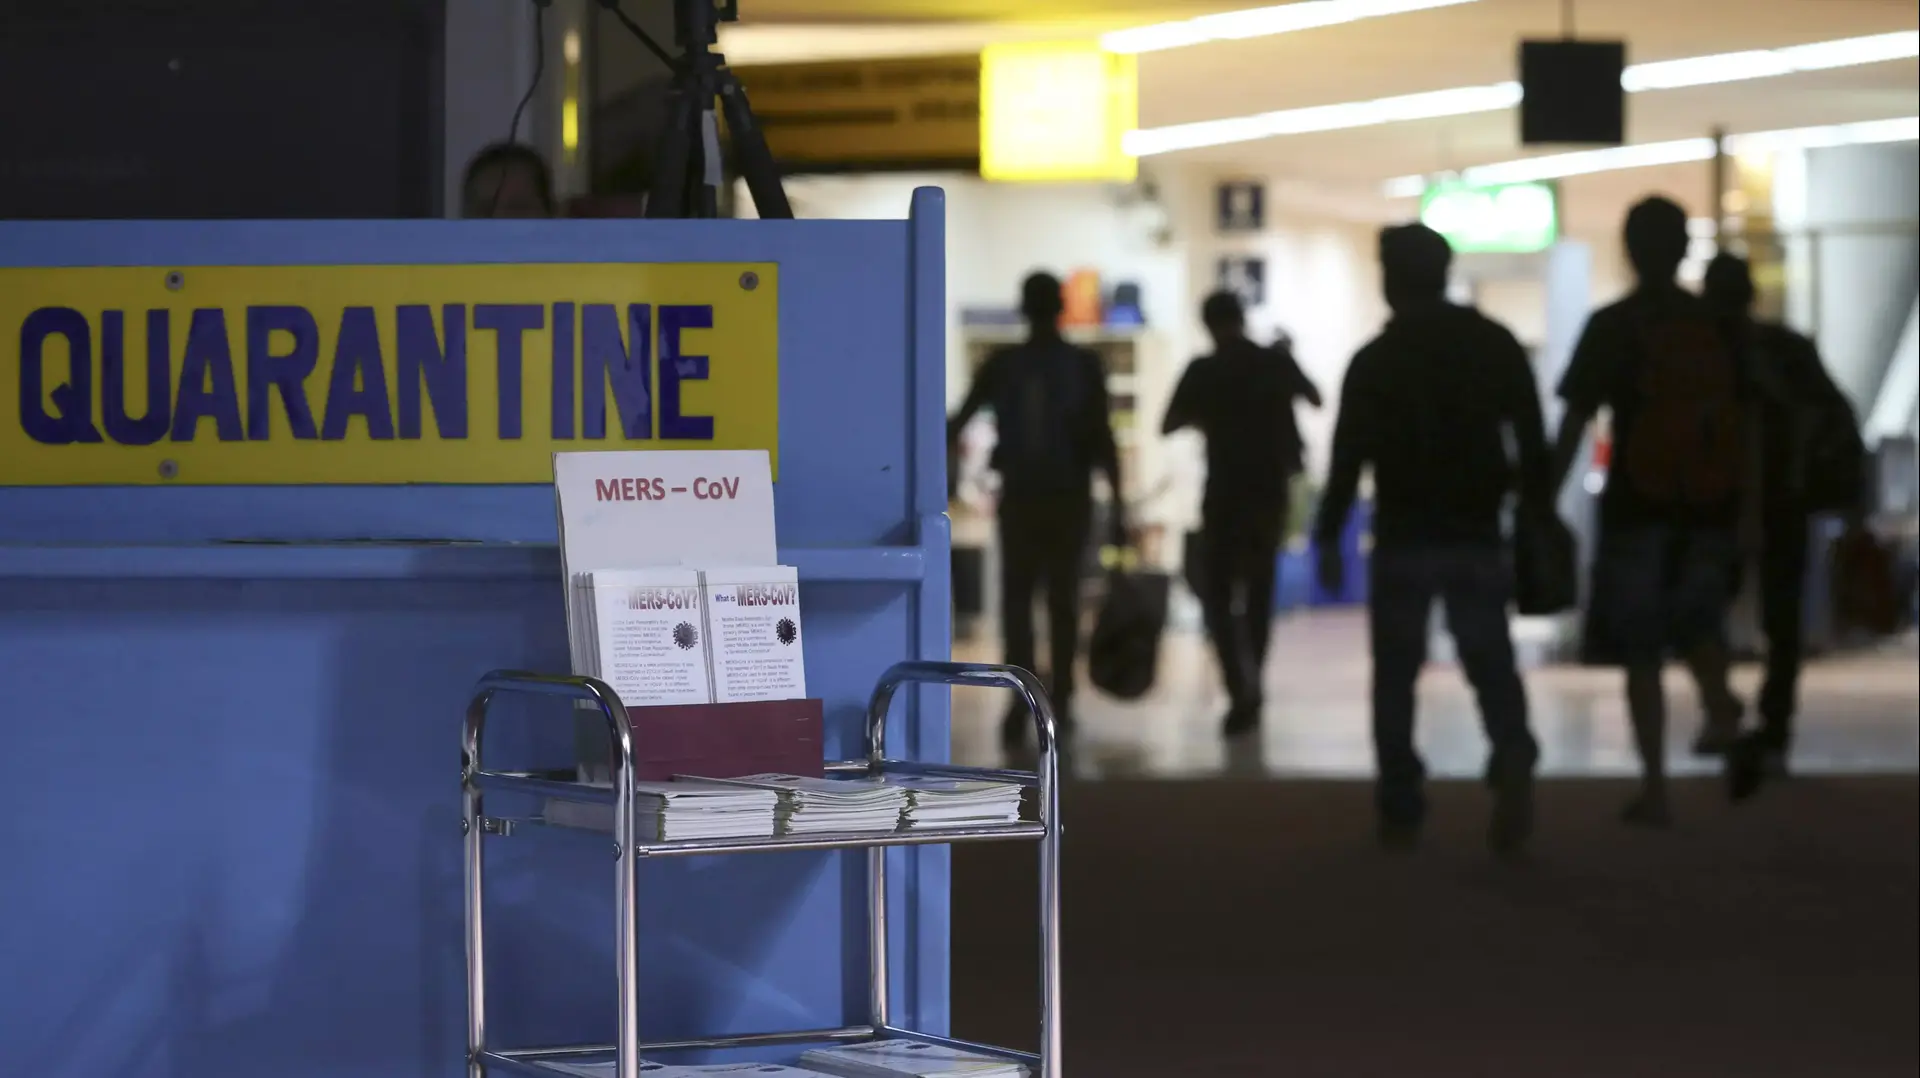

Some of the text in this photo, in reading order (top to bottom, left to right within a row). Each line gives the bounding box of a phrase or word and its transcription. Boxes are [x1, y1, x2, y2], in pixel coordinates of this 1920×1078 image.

[19, 302, 714, 445] QUARANTINE
[595, 478, 665, 501] MERS
[693, 477, 740, 500] CoV
[628, 587, 698, 610] MERS-CoV?
[715, 584, 796, 606] What is MERS-CoV?
